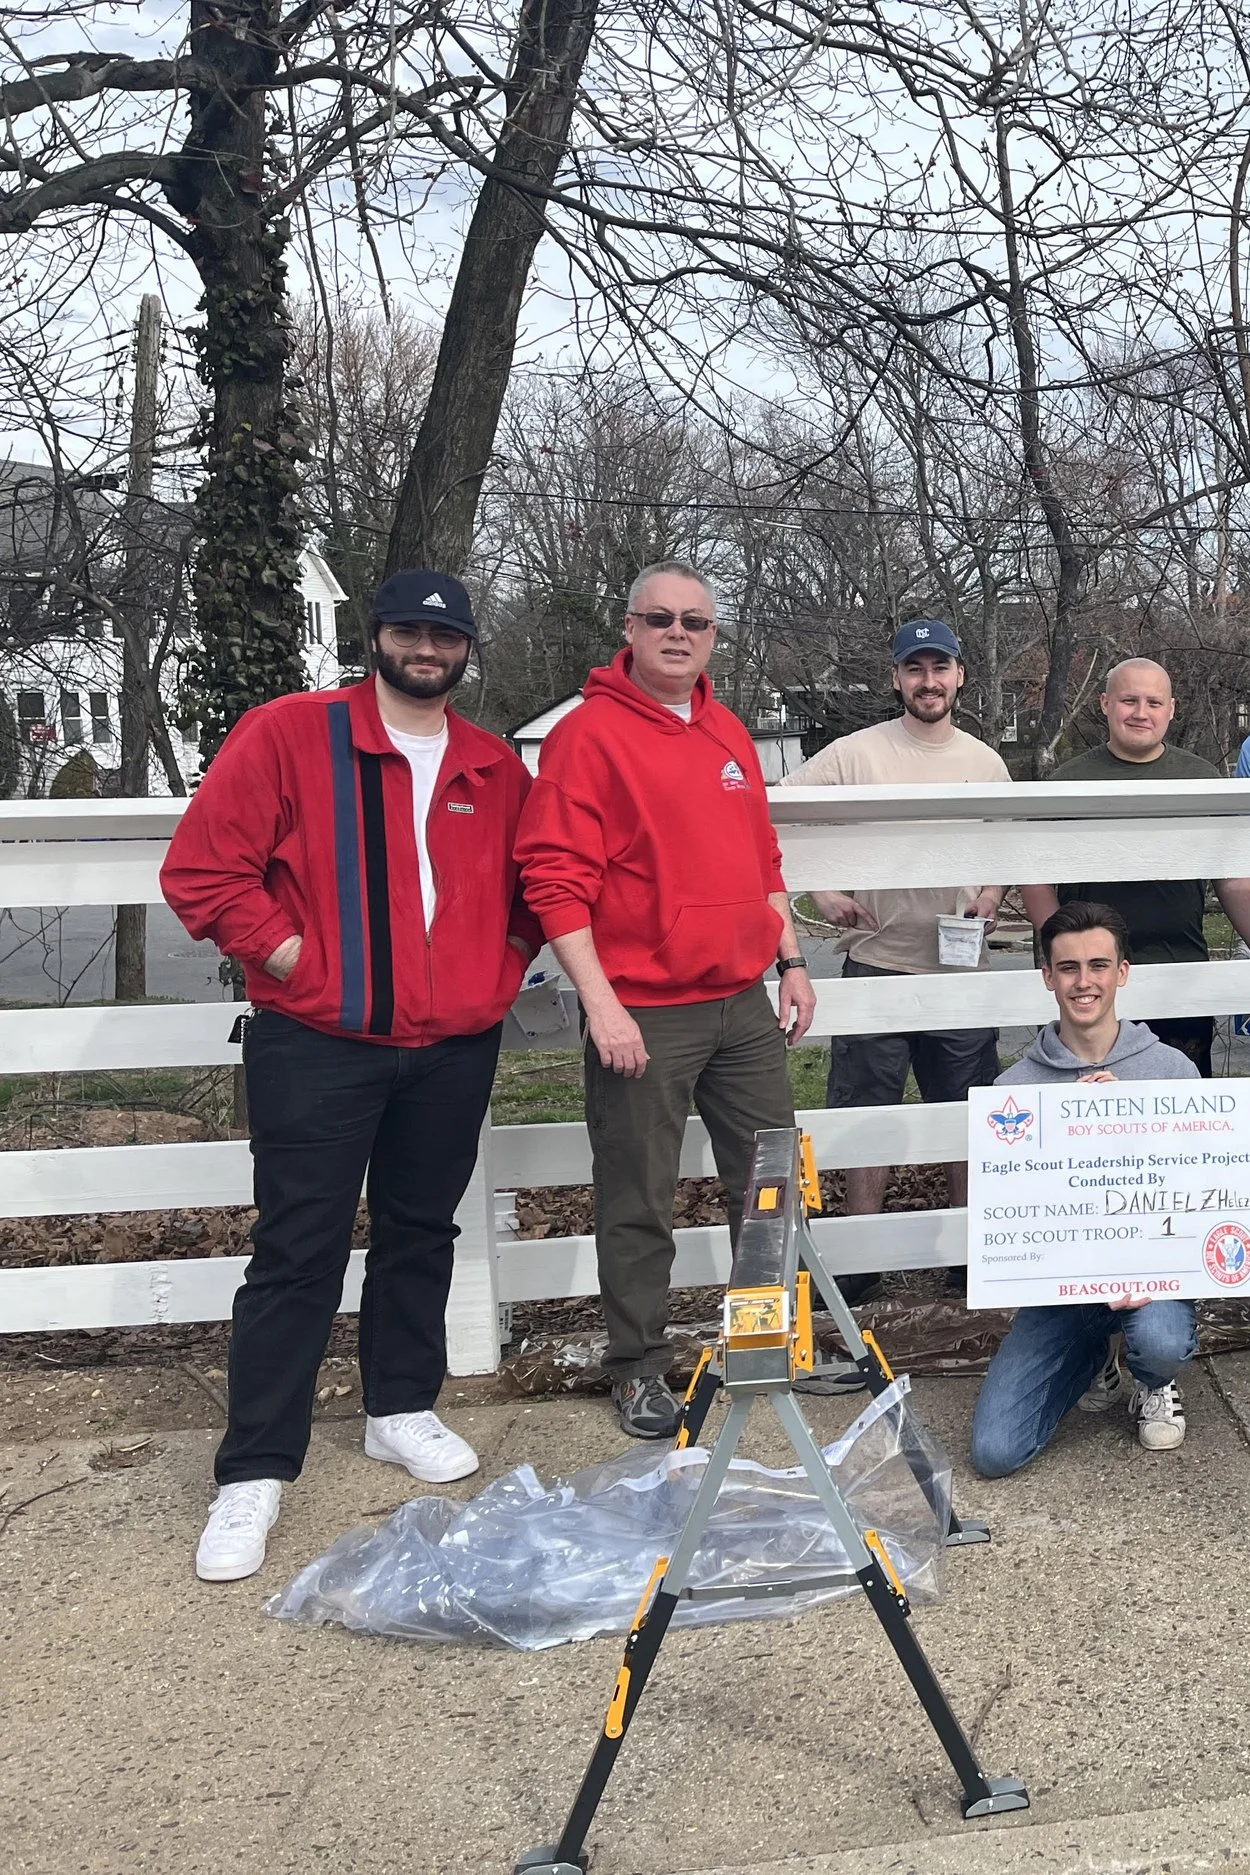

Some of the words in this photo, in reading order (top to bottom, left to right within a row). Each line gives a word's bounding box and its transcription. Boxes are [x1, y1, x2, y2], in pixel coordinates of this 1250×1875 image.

[1060, 1097, 1145, 1119] STATEN
[1153, 1095, 1236, 1115] ISLAND
[1067, 1125, 1094, 1136] BOY
[1097, 1123, 1148, 1135] SCOUTS
[1151, 1122, 1169, 1133] OF
[981, 1160, 1021, 1175] Eagle
[1025, 1159, 1064, 1171] Scout
[1068, 1156, 1144, 1170] Leadership
[1148, 1154, 1198, 1167] Service
[1202, 1152, 1250, 1167] Project
[1068, 1175, 1144, 1188] Conducted
[1148, 1174, 1165, 1187] By
[1105, 1189, 1197, 1215] DANIEL
[983, 1205, 1040, 1220] SCOUT
[1045, 1203, 1099, 1217] NAME:
[1161, 1216, 1176, 1236] 1
[984, 1232, 1017, 1246] BOY
[1022, 1229, 1079, 1244] SCOUT
[1082, 1226, 1143, 1241] TROOP:
[981, 1253, 1027, 1264] Sponsored
[1059, 1280, 1180, 1296] BEASCOUT.ORG
